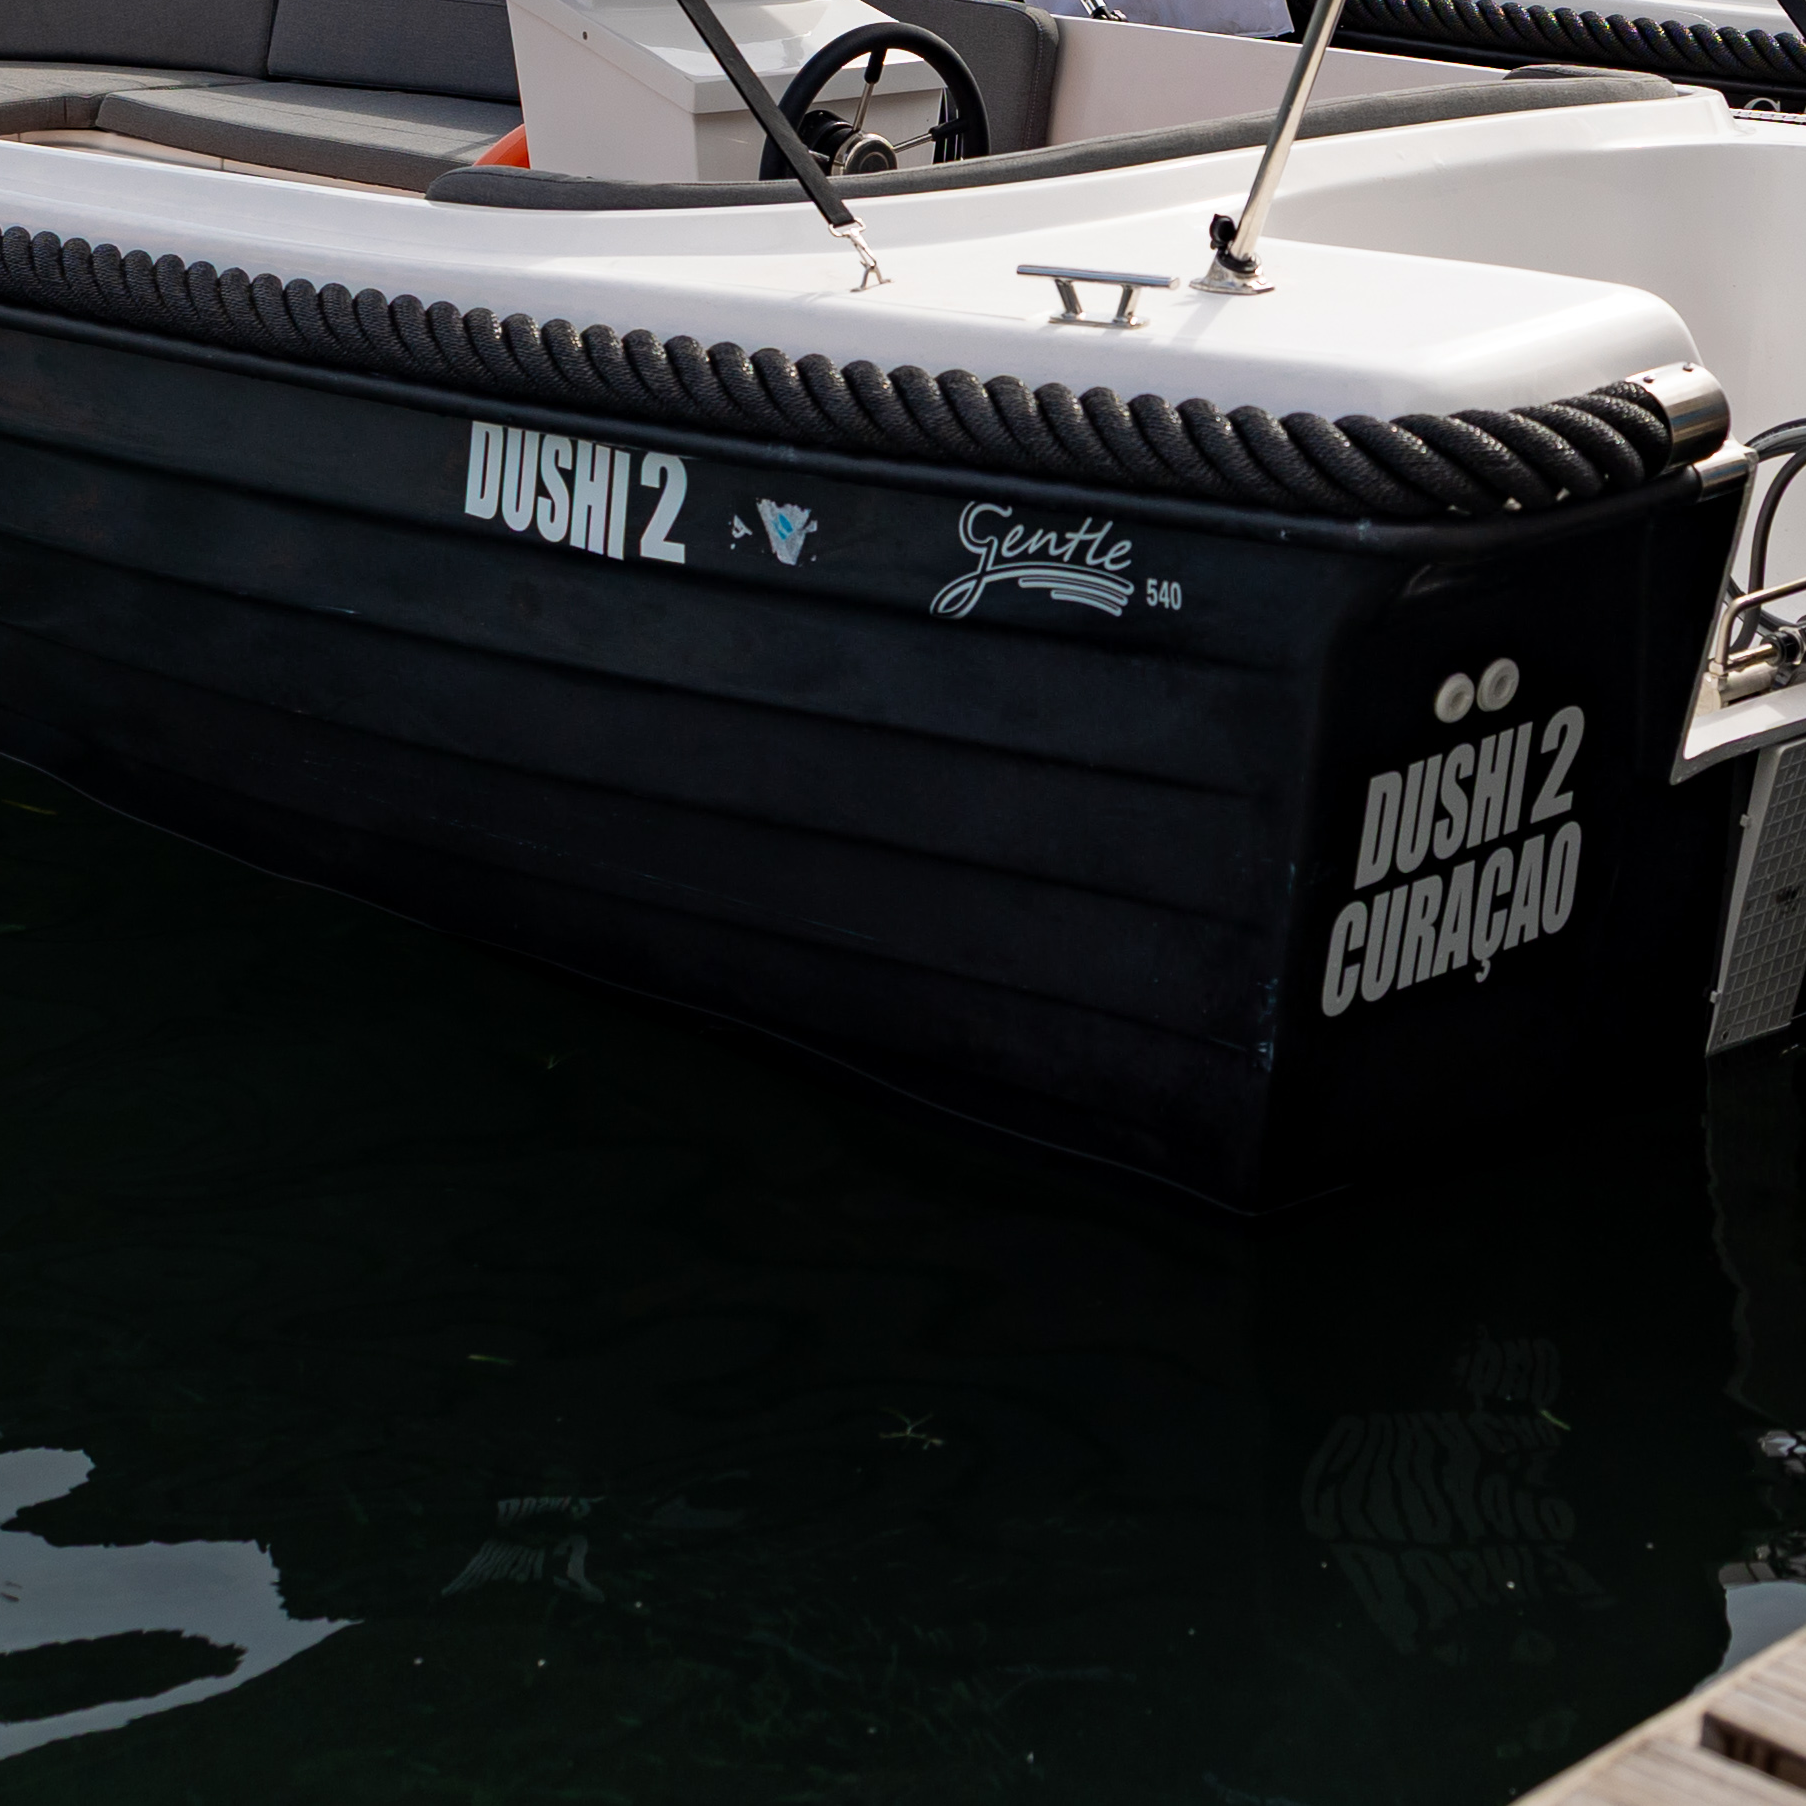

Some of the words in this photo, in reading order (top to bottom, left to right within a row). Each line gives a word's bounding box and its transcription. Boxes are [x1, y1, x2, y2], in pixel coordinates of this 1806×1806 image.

[464, 420, 631, 561] DUSHI
[640, 451, 688, 564] 2
[944, 501, 1133, 594] Gentle
[1146, 578, 1182, 611] 540
[1354, 720, 1533, 890] DUSHI
[1530, 705, 1585, 824] 2
[1321, 820, 1582, 1017] CURAÇAO
